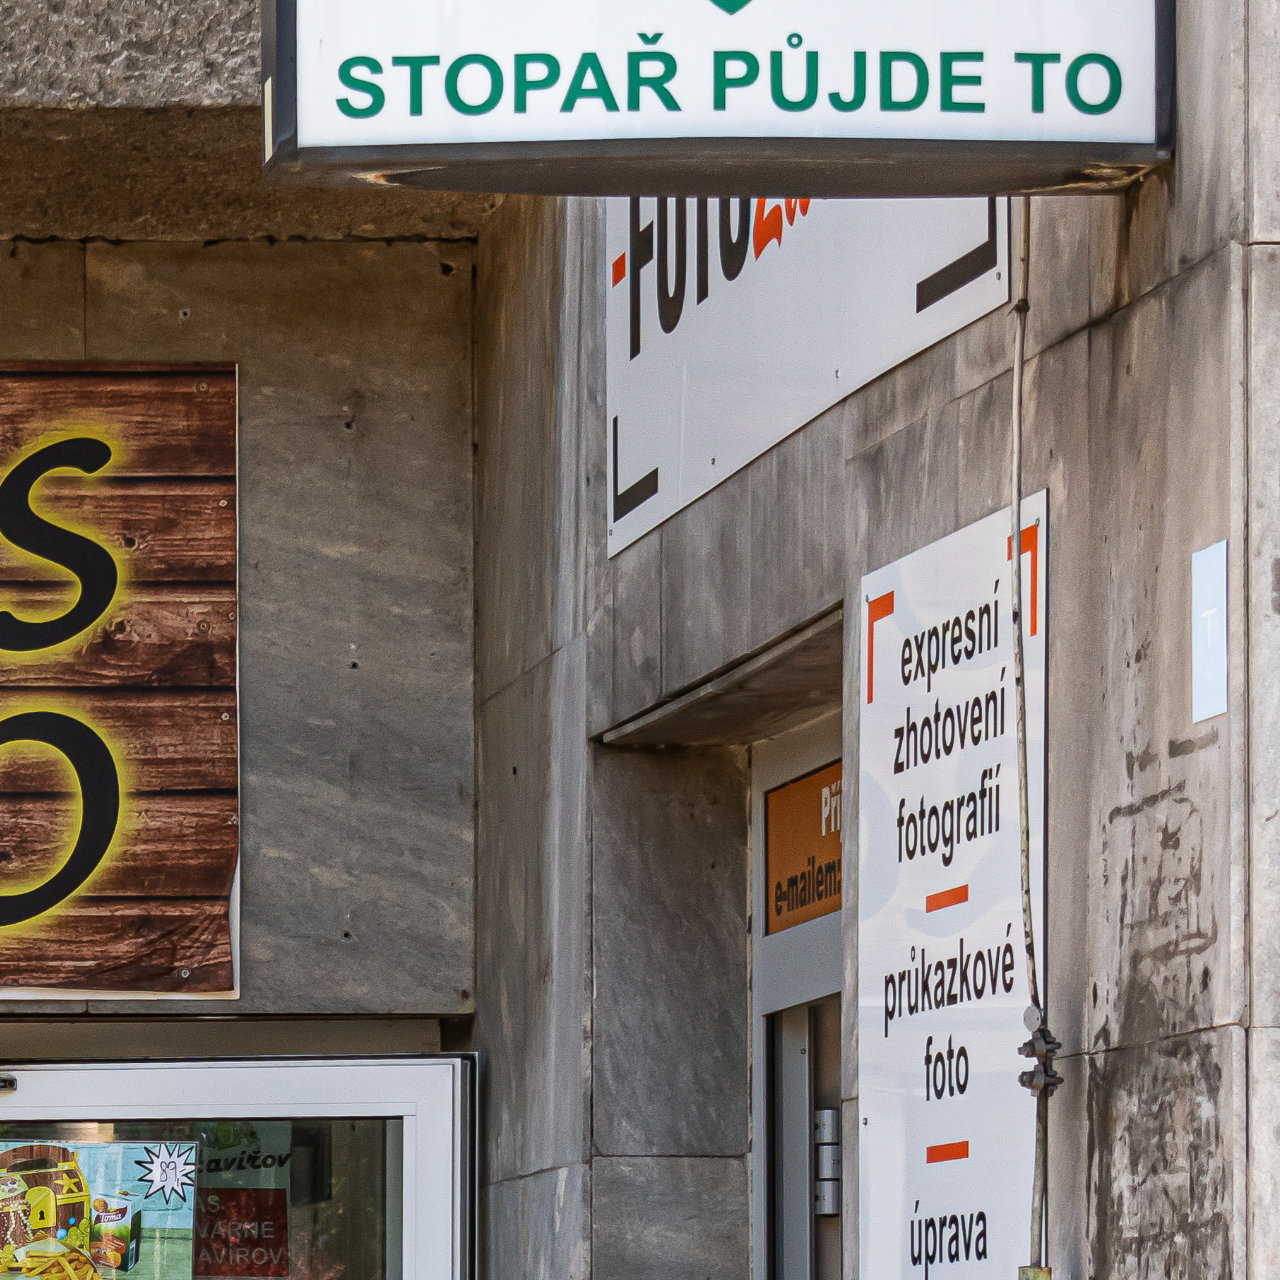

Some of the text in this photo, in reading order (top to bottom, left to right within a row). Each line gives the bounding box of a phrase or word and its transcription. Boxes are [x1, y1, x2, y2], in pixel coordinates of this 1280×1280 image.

[336, 33, 1122, 117] STOPAŘ PŮJDE TO
[901, 578, 1000, 693] expresní
[893, 666, 1006, 775] zhotovení
[897, 763, 1001, 867] fotografií
[884, 922, 1015, 1038] průkazkové
[924, 1033, 969, 1102] foto
[197, 1147, 290, 1174] avířov
